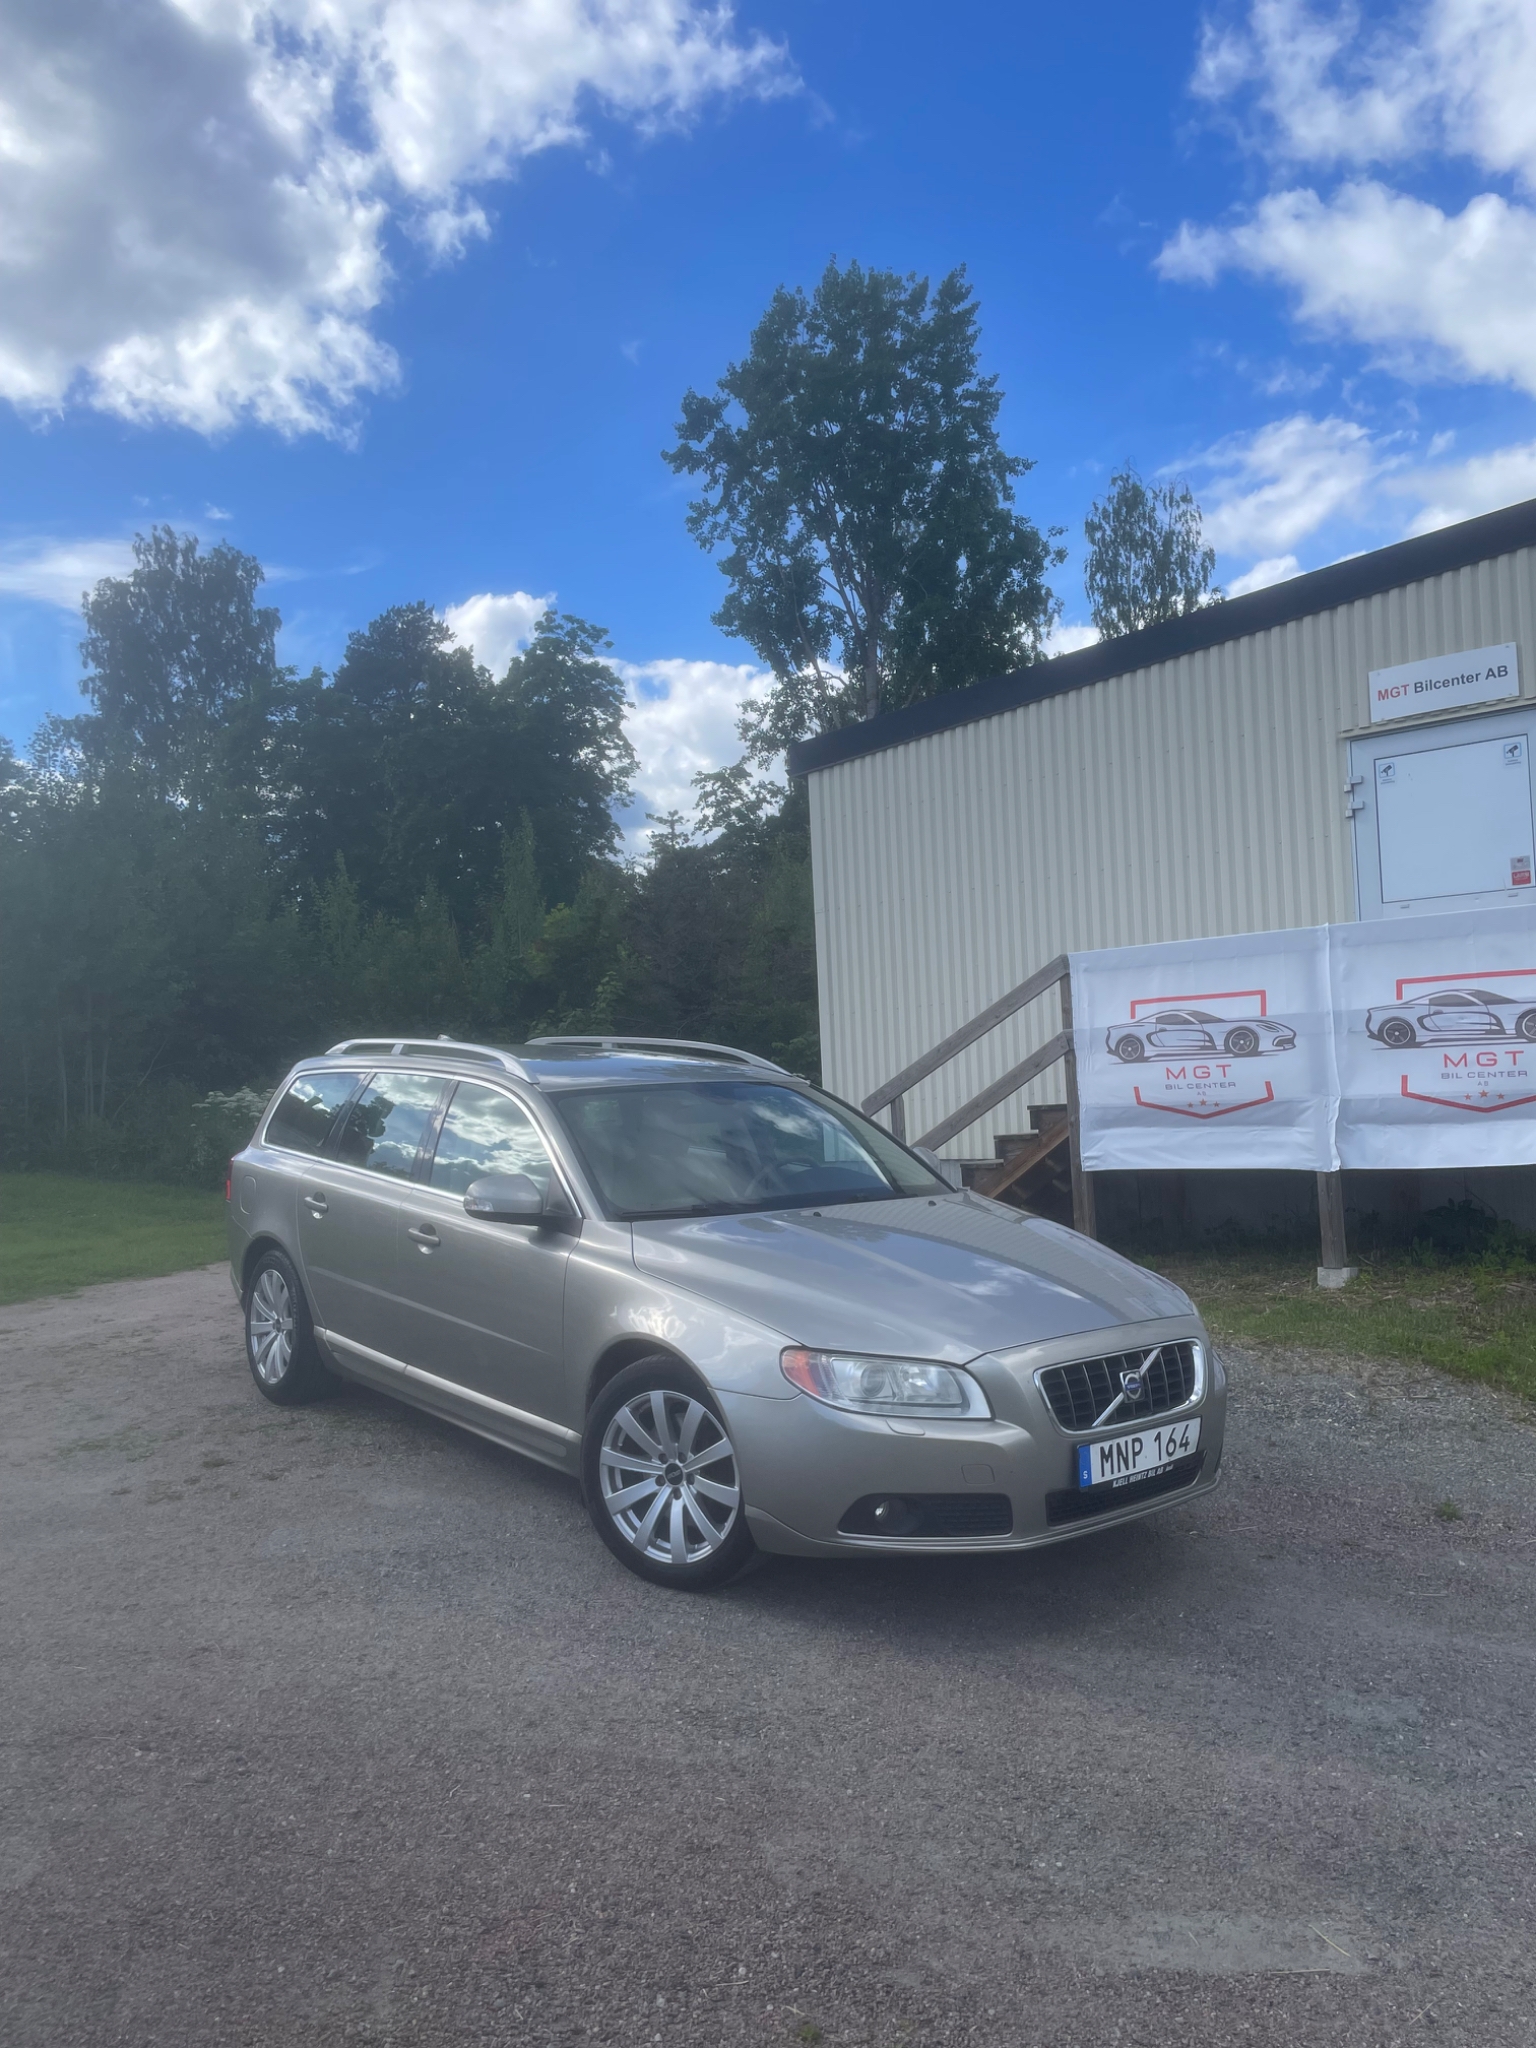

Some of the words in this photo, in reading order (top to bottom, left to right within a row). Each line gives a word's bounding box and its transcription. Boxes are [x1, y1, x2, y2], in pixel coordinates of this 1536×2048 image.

[1377, 684, 1410, 701] MGT
[1414, 672, 1481, 694] Bilcenter
[1485, 665, 1508, 681] AB
[1443, 1050, 1525, 1068] MGT
[1165, 1064, 1232, 1080] MGT
[1441, 1072, 1463, 1080] BIL
[1467, 1070, 1528, 1079] CENTER
[1165, 1083, 1184, 1091] BIL
[1186, 1081, 1237, 1090] CENTER
[1100, 1437, 1143, 1477] MNP
[1154, 1424, 1190, 1461] 164
[1083, 1470, 1088, 1479] S
